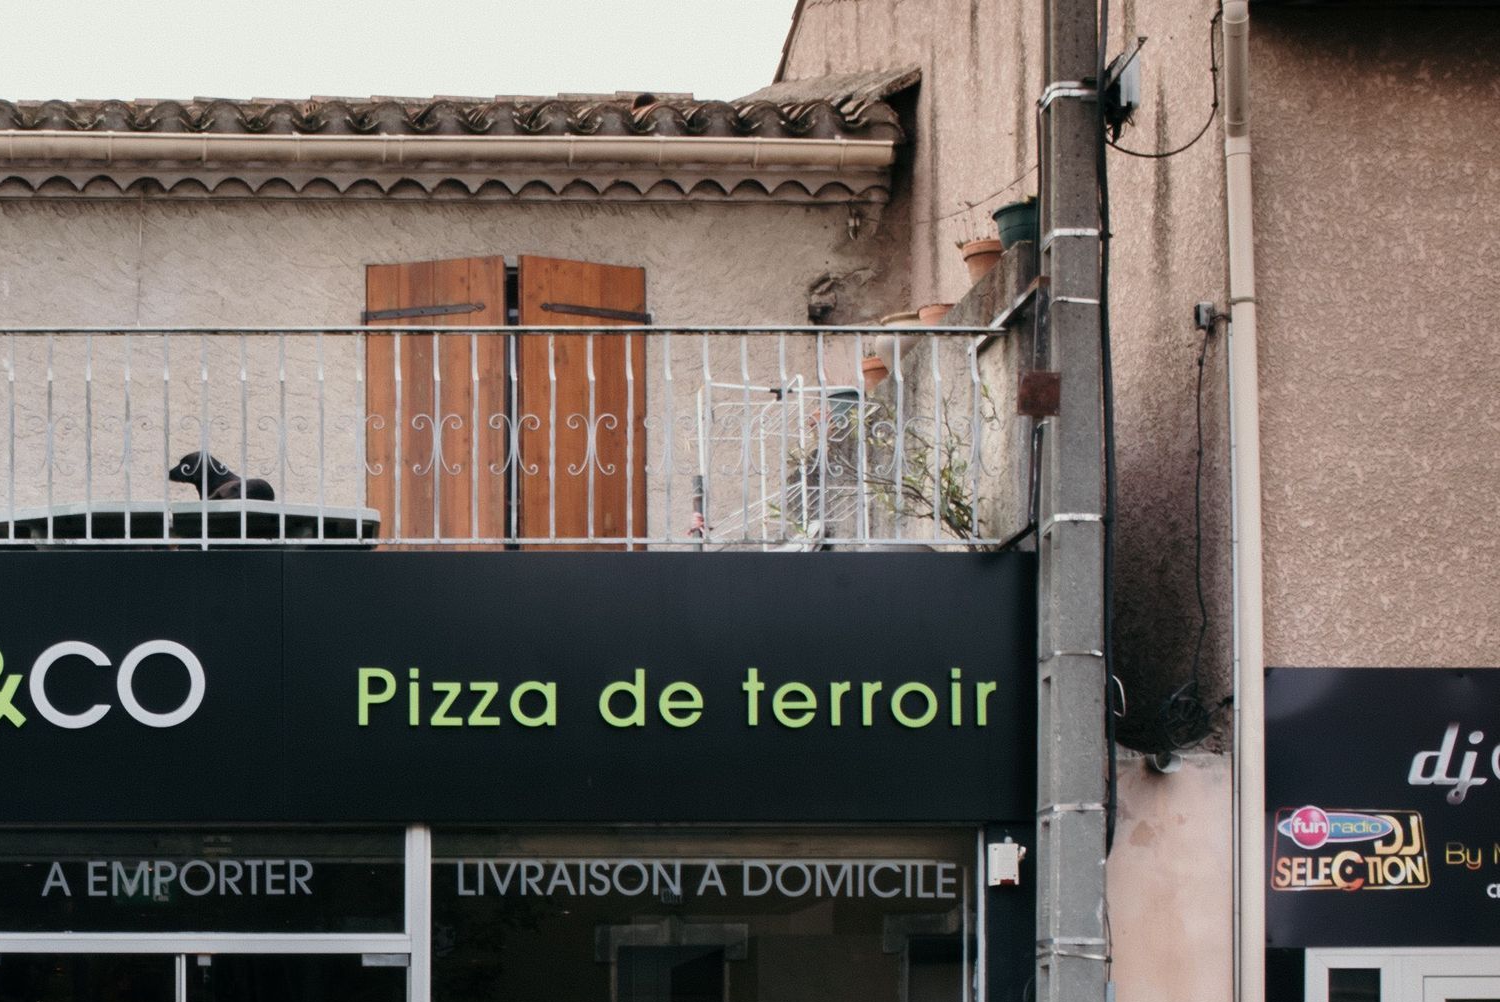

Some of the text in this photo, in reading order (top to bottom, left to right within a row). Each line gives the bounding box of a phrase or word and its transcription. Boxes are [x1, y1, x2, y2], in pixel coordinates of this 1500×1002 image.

[358, 667, 997, 729] Pizza de terroir
[1407, 721, 1500, 805] dj
[1293, 818, 1383, 835] fun radio
[1275, 850, 1426, 892] SELECTION
[1445, 841, 1482, 870] By
[41, 859, 314, 898] A EMPORTER
[456, 860, 957, 899] LIVRAISON A DOMICILE
